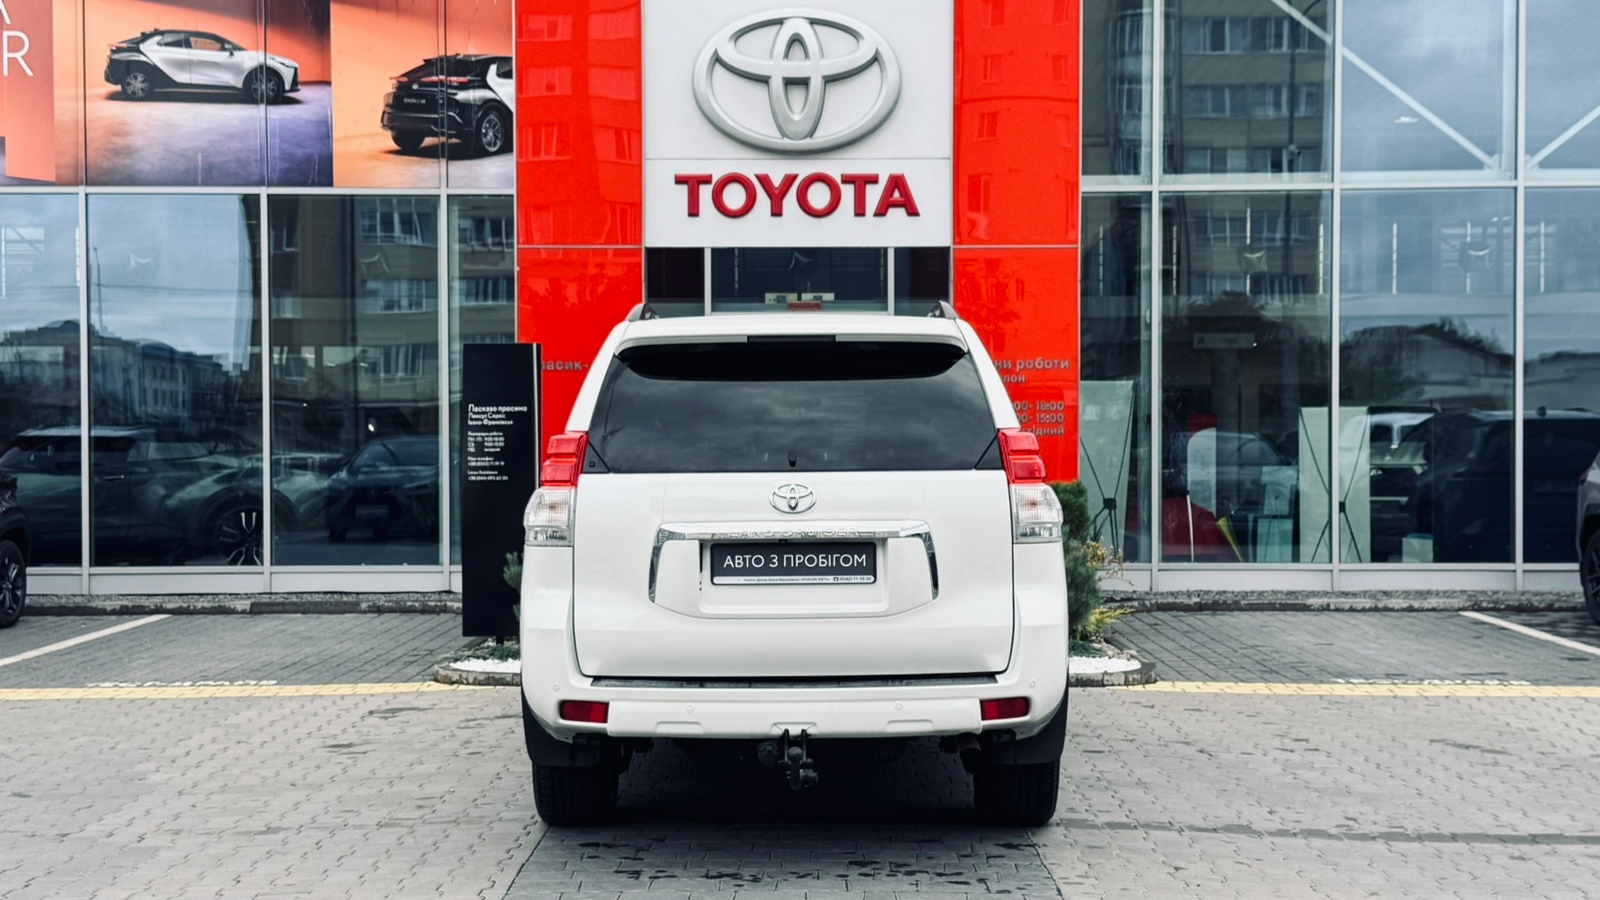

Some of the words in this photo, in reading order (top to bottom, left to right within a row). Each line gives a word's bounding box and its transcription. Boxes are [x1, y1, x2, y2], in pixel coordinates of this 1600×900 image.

[674, 172, 920, 218] TOYOTA
[1016, 357, 1069, 372] роботи
[1036, 401, 1064, 411] 18:00
[1036, 413, 1064, 423] 15:00
[723, 555, 764, 568] АВТО
[783, 554, 867, 567] ПРОБІГОМ
